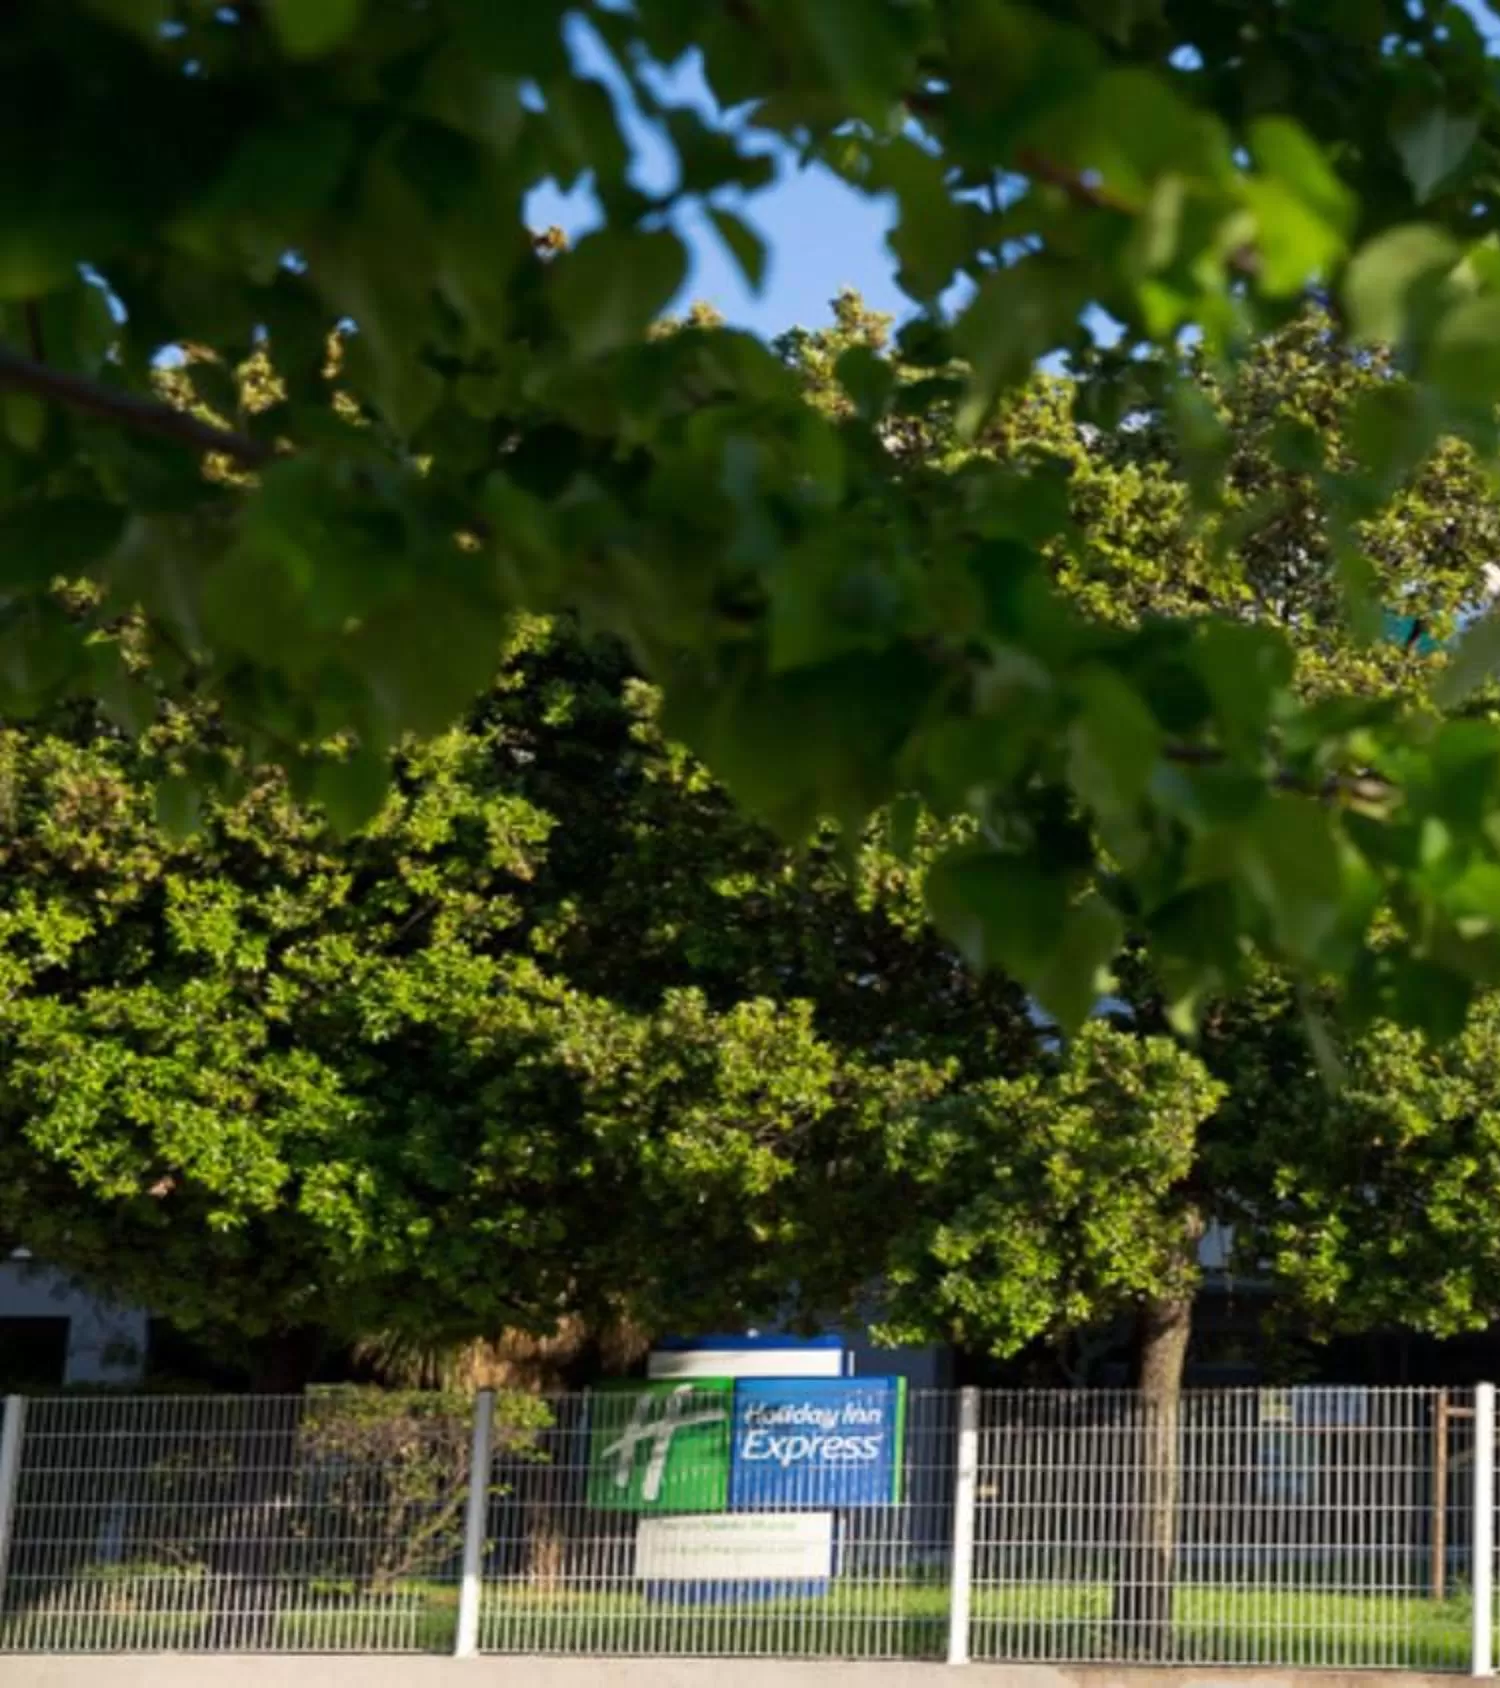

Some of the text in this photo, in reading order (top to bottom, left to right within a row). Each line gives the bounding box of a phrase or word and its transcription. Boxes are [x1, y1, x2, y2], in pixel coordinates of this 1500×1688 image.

[743, 1400, 883, 1430] Holiday Inn
[742, 1428, 884, 1468] Express
